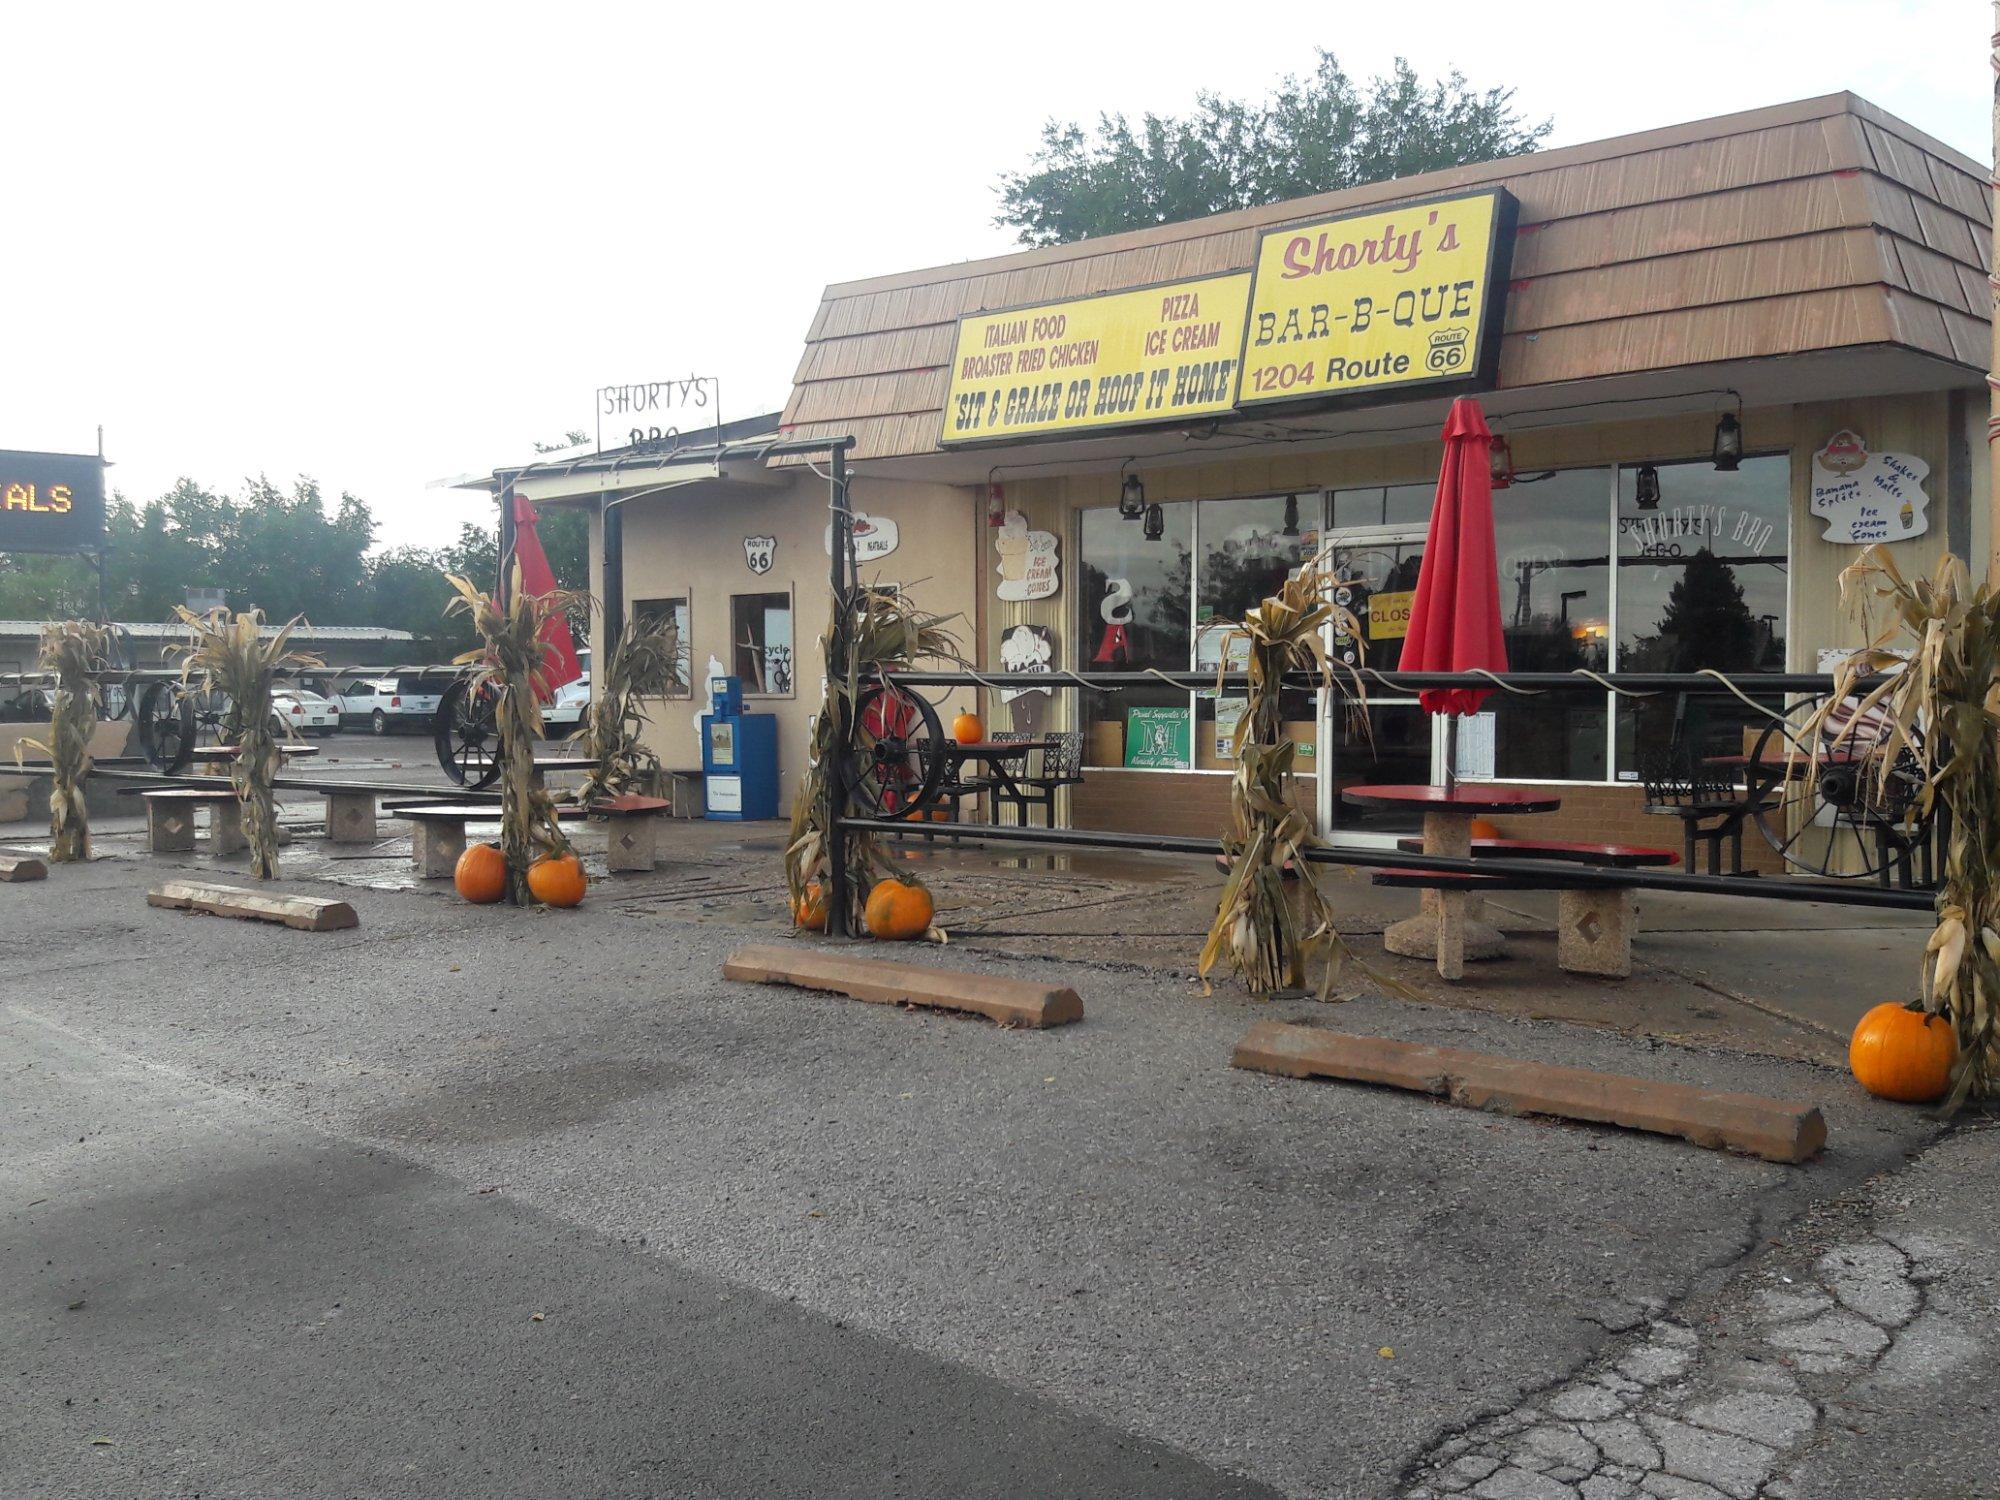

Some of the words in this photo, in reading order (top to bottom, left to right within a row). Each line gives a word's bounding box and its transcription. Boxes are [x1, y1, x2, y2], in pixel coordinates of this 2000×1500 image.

[1281, 210, 1460, 280] Shorty's
[1161, 293, 1199, 323] PIZZA
[1254, 280, 1474, 347] BAR-B-QUE
[984, 320, 1028, 349] ITALIAN
[1031, 314, 1066, 342] FOOD
[1144, 329, 1168, 357] ICE
[1172, 321, 1221, 353] CREAM
[1434, 332, 1463, 343] ROUTE
[961, 351, 1013, 380] BROASTER
[1016, 347, 1046, 374] FRIED
[1050, 339, 1100, 370] CHICKEN
[1430, 347, 1461, 368] 66
[1252, 361, 1315, 393] 1204
[1326, 352, 1410, 383] Route
[988, 389, 1001, 427] &
[1003, 382, 1063, 426] GRAZE
[1064, 378, 1091, 419] OR
[1093, 371, 1145, 416] HOOF
[1145, 368, 1170, 410] IT
[1882, 456, 1920, 482] Shakes
[0, 484, 72, 512] ALS
[1815, 481, 1859, 498] Banana
[1873, 475, 1904, 498] Malts
[747, 540, 771, 548] ROUTE
[749, 552, 769, 568] 66
[1033, 556, 1047, 567] ICE
[1370, 608, 1411, 623] CLOS
